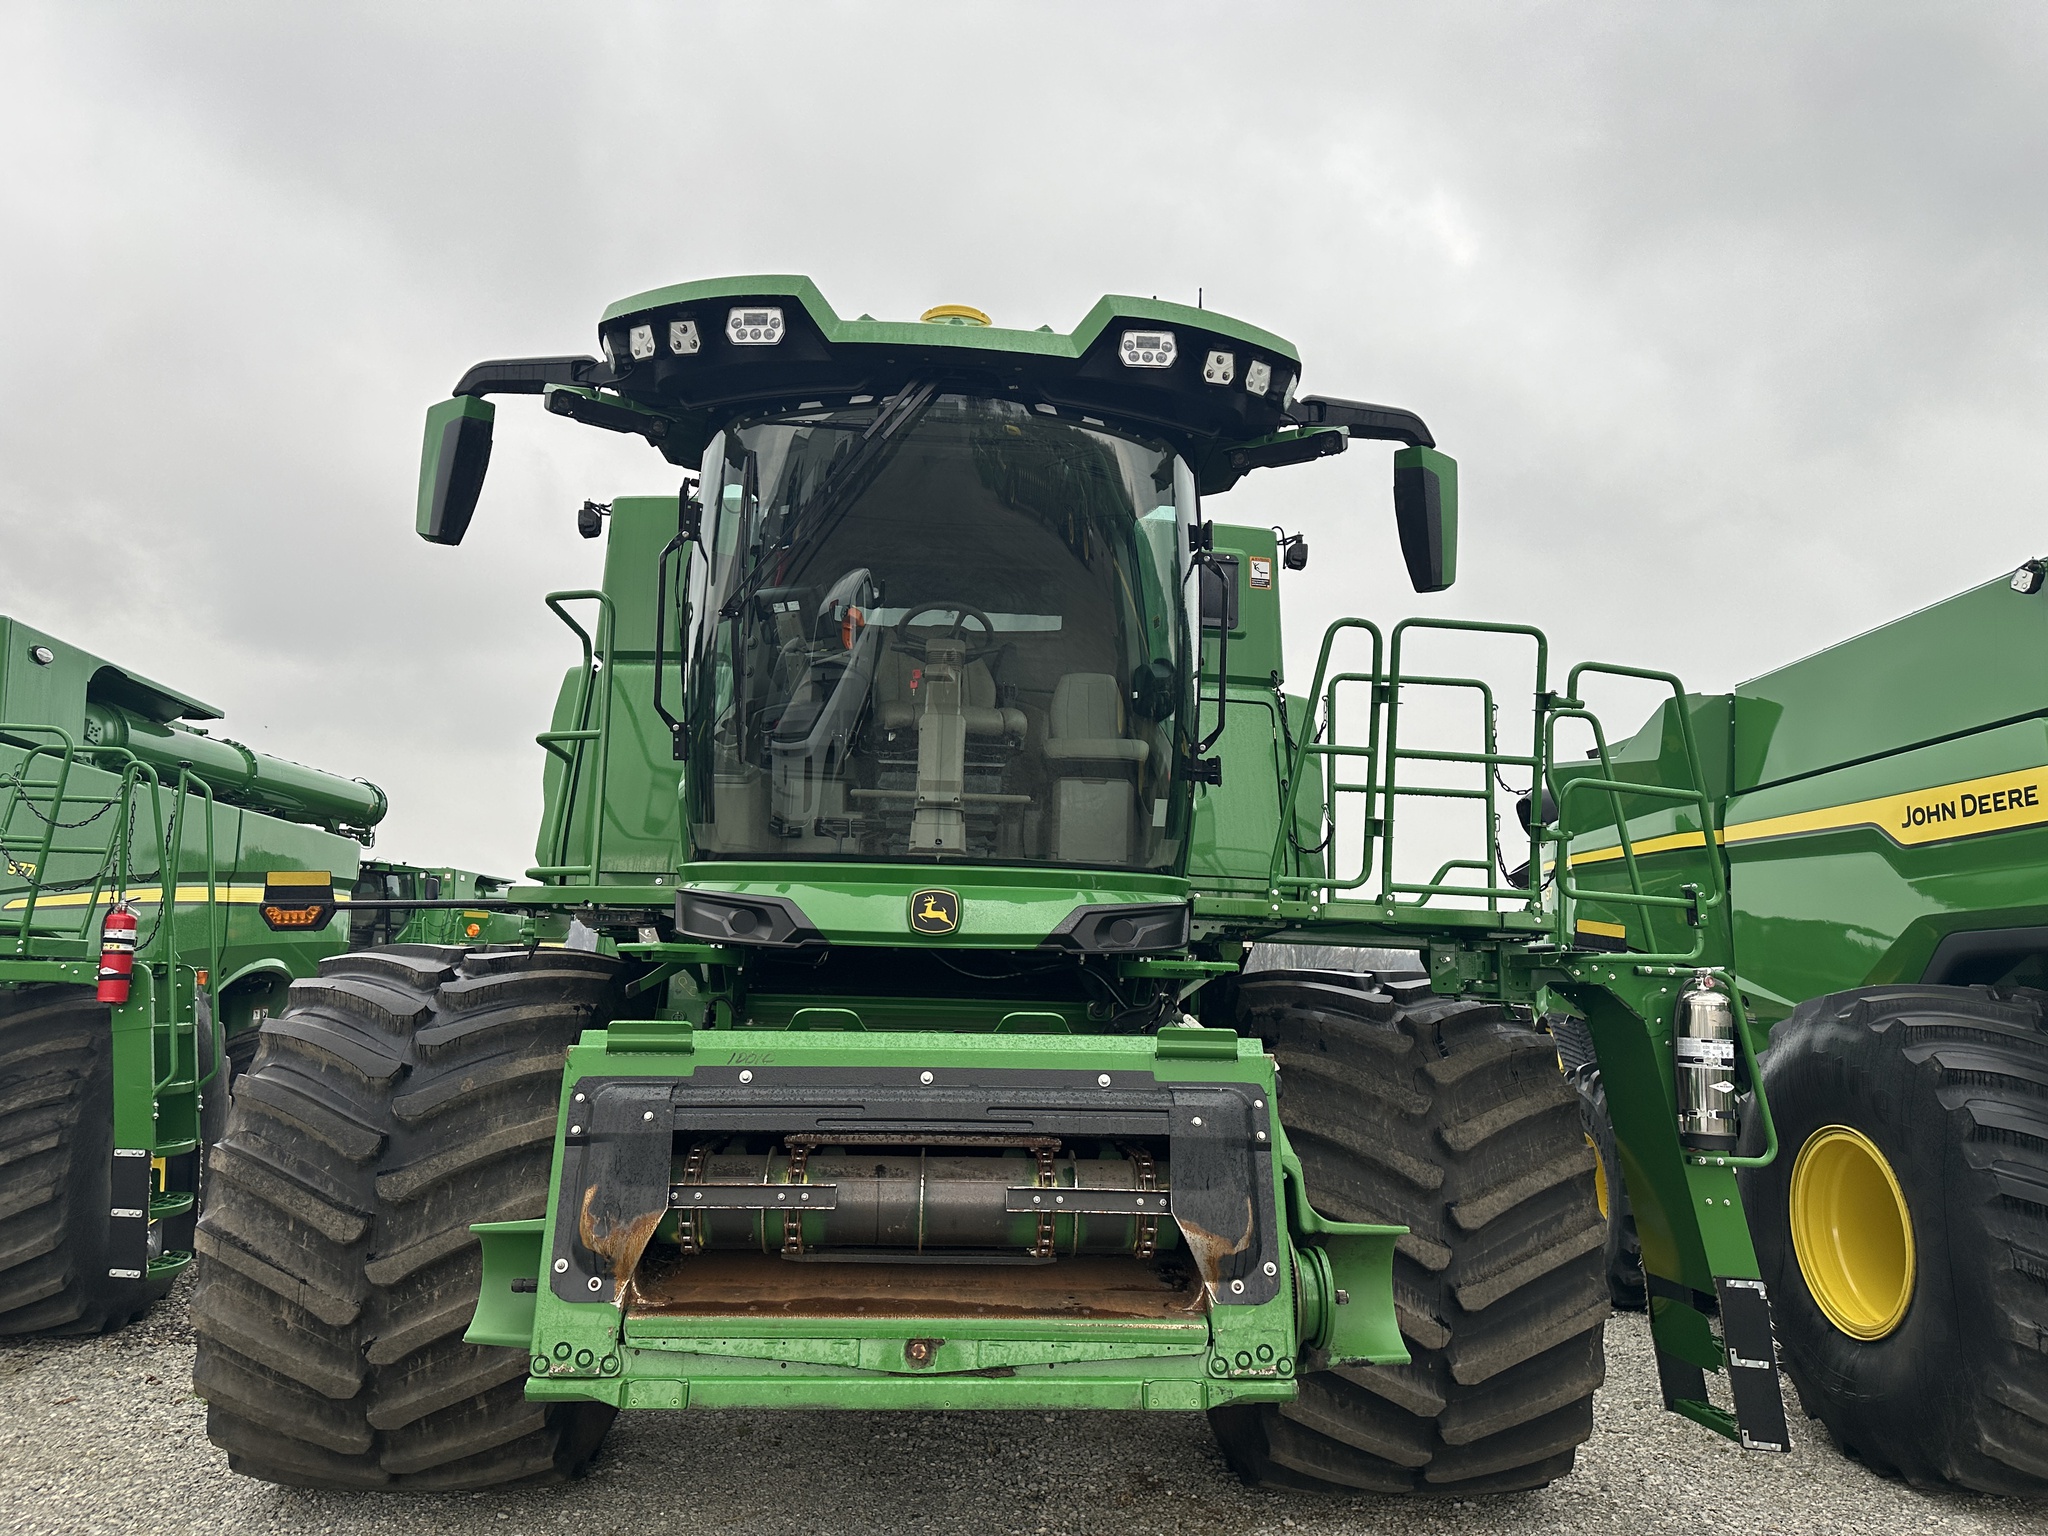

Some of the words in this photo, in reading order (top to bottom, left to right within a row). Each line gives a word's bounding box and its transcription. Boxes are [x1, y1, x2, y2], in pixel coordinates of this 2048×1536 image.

[1901, 801, 1957, 829] JOHN
[1960, 785, 2039, 818] DEERE
[7, 861, 37, 878] S77
